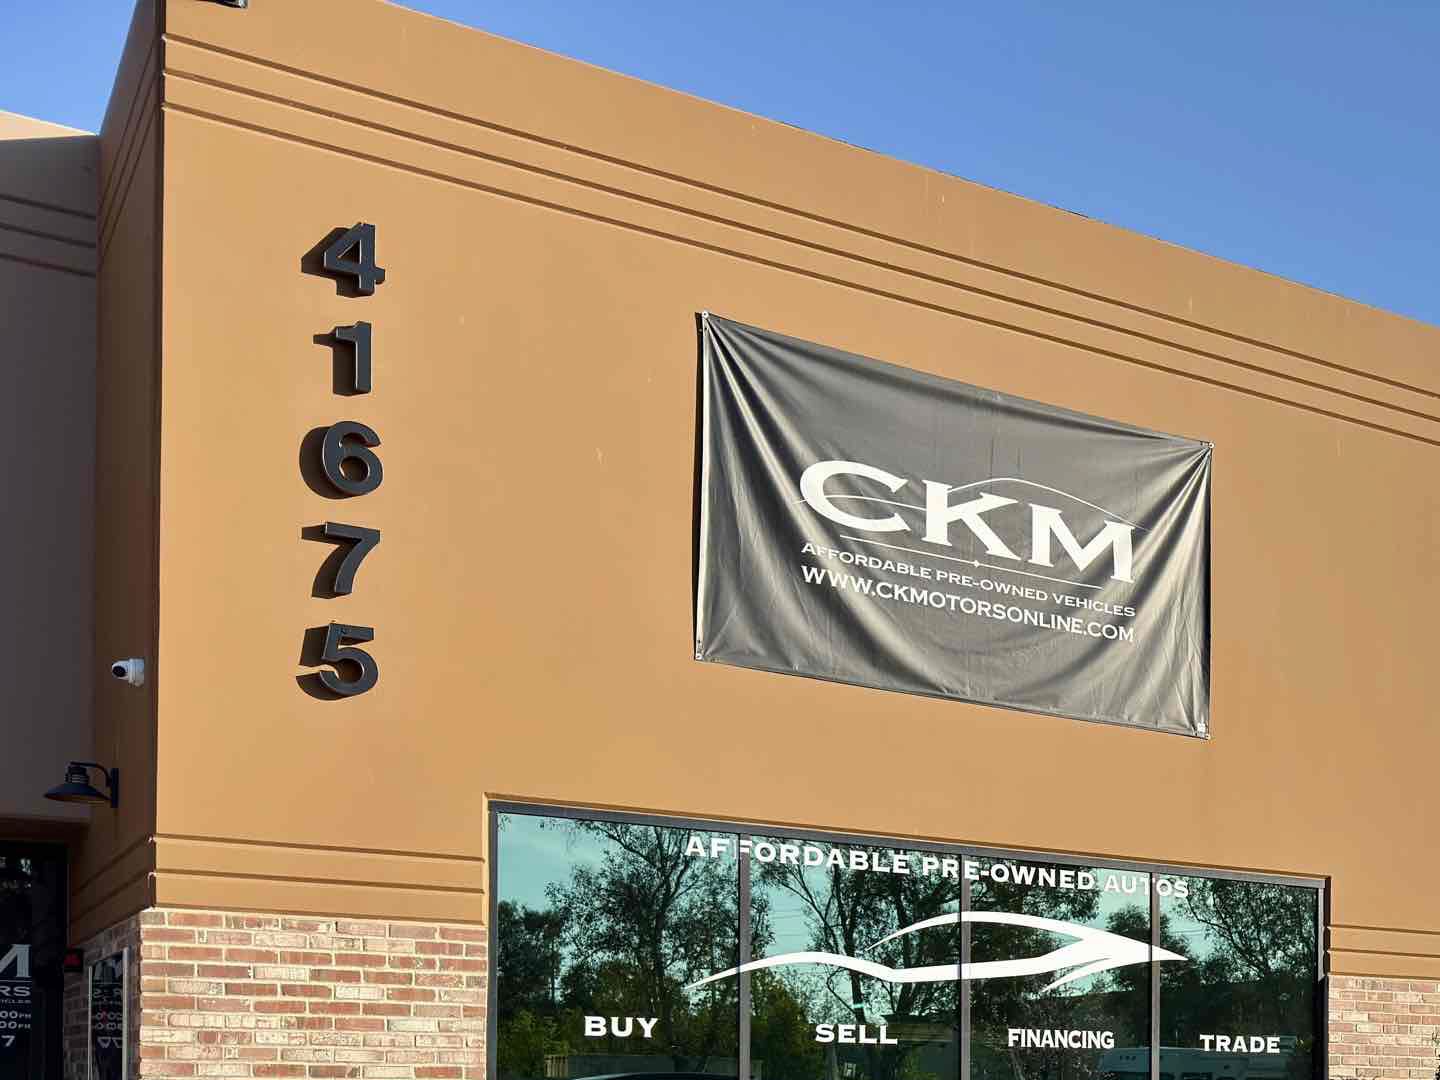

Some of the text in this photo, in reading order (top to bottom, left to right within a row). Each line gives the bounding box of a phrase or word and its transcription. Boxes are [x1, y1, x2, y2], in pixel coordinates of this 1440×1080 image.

[298, 222, 385, 700] 41675
[799, 460, 1134, 582] CKM
[800, 543, 1136, 618] AFFORDABLE PRE-OWNED VEHICLES
[800, 565, 1135, 643] WWW.CKMOTORSONLINE.COM
[685, 836, 1189, 899] AFFORDABLE PRE-OWNED AUTOS
[584, 1015, 658, 1038] BUY
[815, 1023, 898, 1045] SELL
[1007, 1028, 1115, 1049] FINANCING
[1200, 1034, 1280, 1054] TRADE
